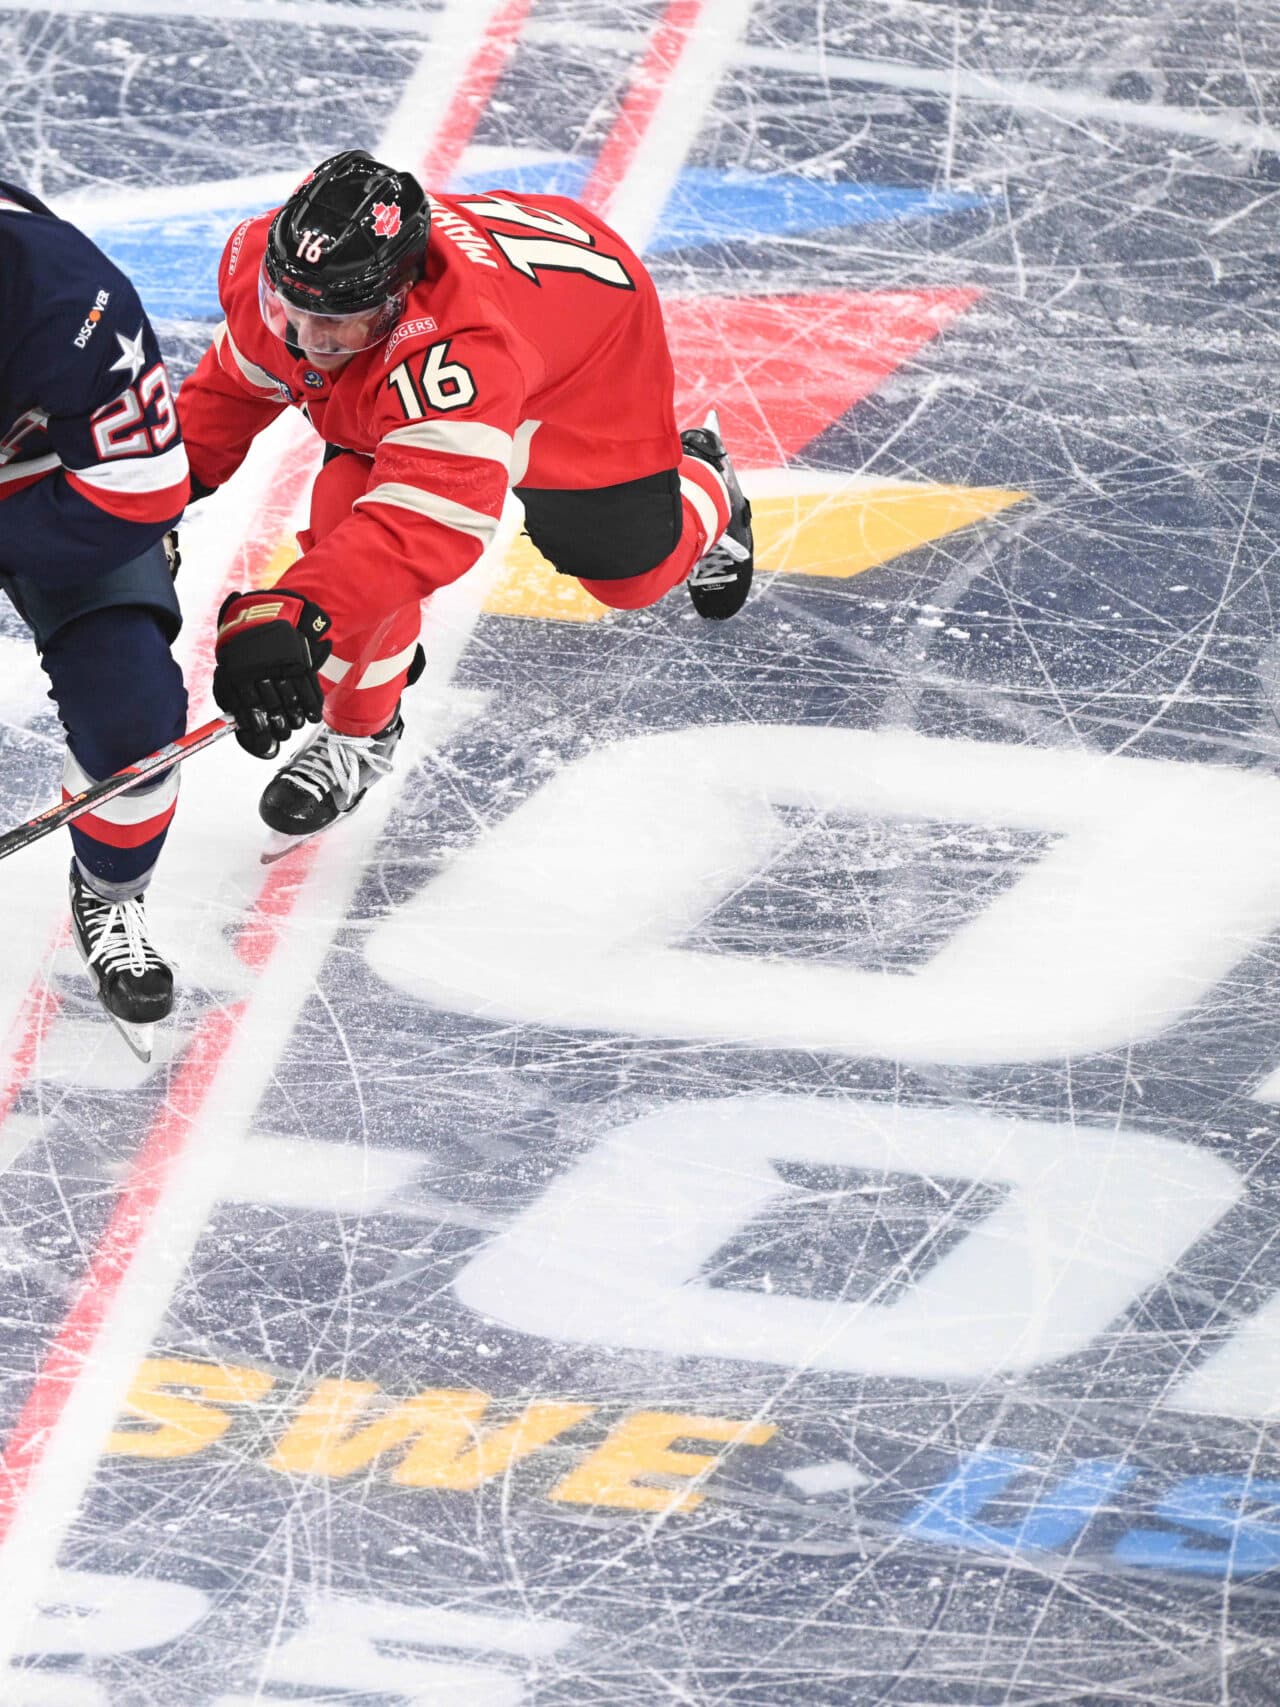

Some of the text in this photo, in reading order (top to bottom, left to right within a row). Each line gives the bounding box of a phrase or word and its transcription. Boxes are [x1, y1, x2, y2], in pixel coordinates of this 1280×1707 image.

[296, 230, 324, 263] 16
[281, 275, 322, 297] CCM
[73, 289, 110, 349] DISCOVER
[388, 319, 434, 351] ROGERS
[387, 339, 478, 420] 16
[90, 361, 178, 461] 23
[104, 1354, 778, 1513] SWE
